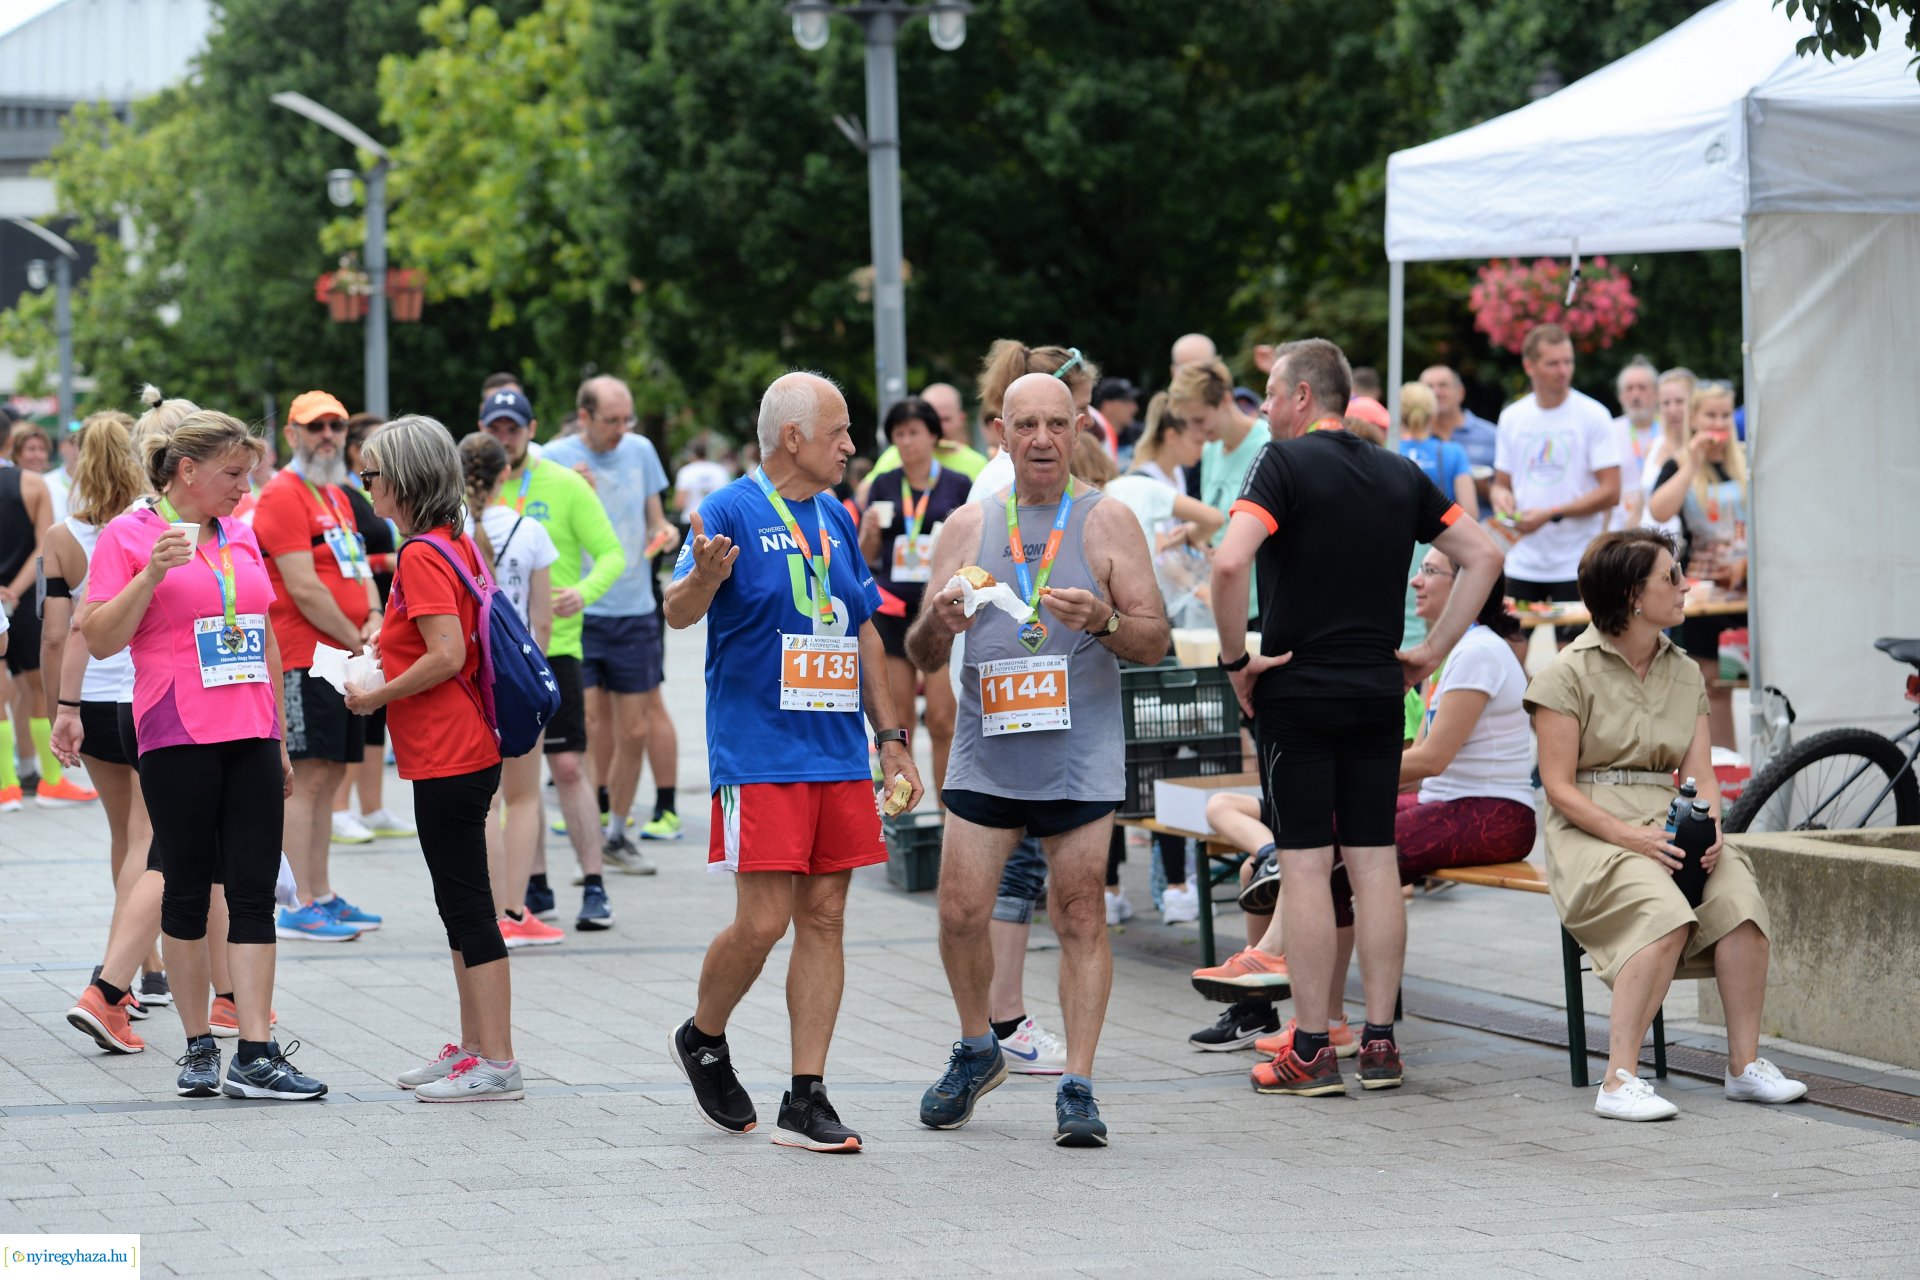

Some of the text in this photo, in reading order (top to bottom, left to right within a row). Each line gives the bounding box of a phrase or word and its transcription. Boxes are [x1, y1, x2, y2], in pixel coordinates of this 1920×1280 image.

[758, 525, 786, 534] POWERED
[1003, 543, 1046, 558] SCONY
[793, 653, 855, 680] 1135
[986, 673, 1058, 703] 1144
